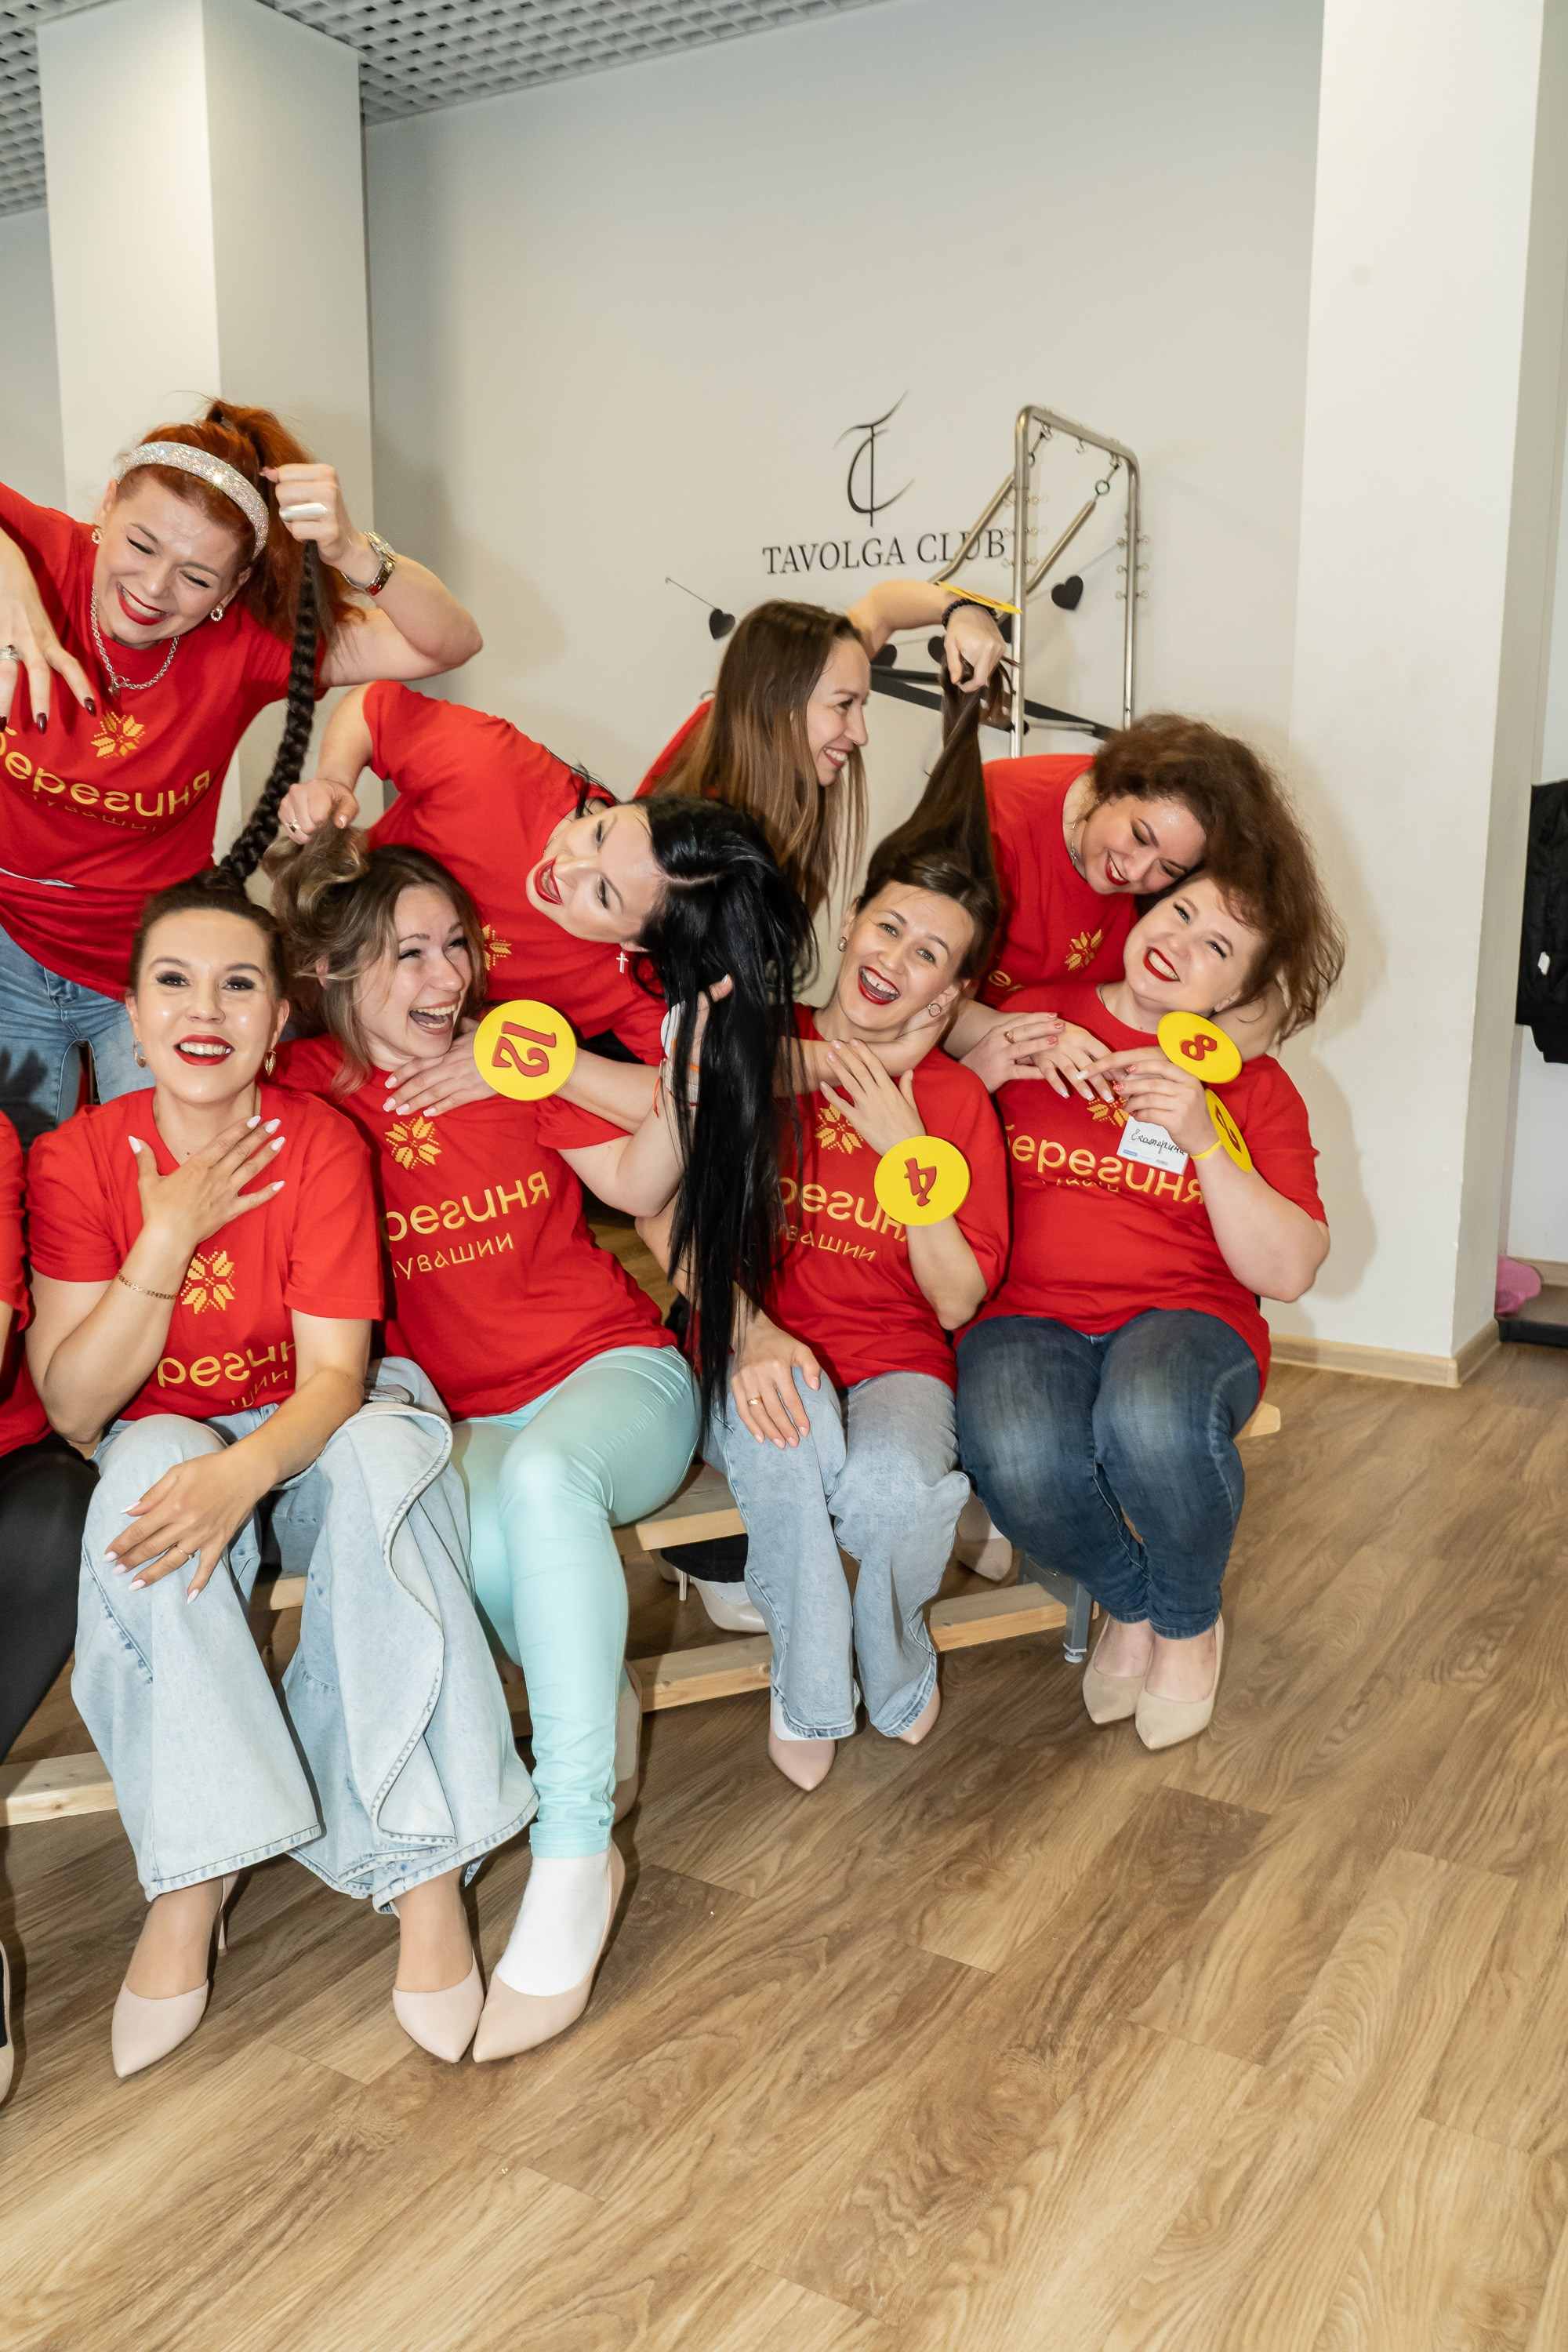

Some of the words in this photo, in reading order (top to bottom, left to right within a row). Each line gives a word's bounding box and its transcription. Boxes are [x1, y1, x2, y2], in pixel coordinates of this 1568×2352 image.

[762, 536, 906, 575] TAVOLGA
[916, 528, 1005, 564] CLUB
[492, 1021, 556, 1077] 12
[1180, 1034, 1217, 1061] 8
[903, 1157, 937, 1207] 4
[1000, 1124, 1204, 1204] ерегиня
